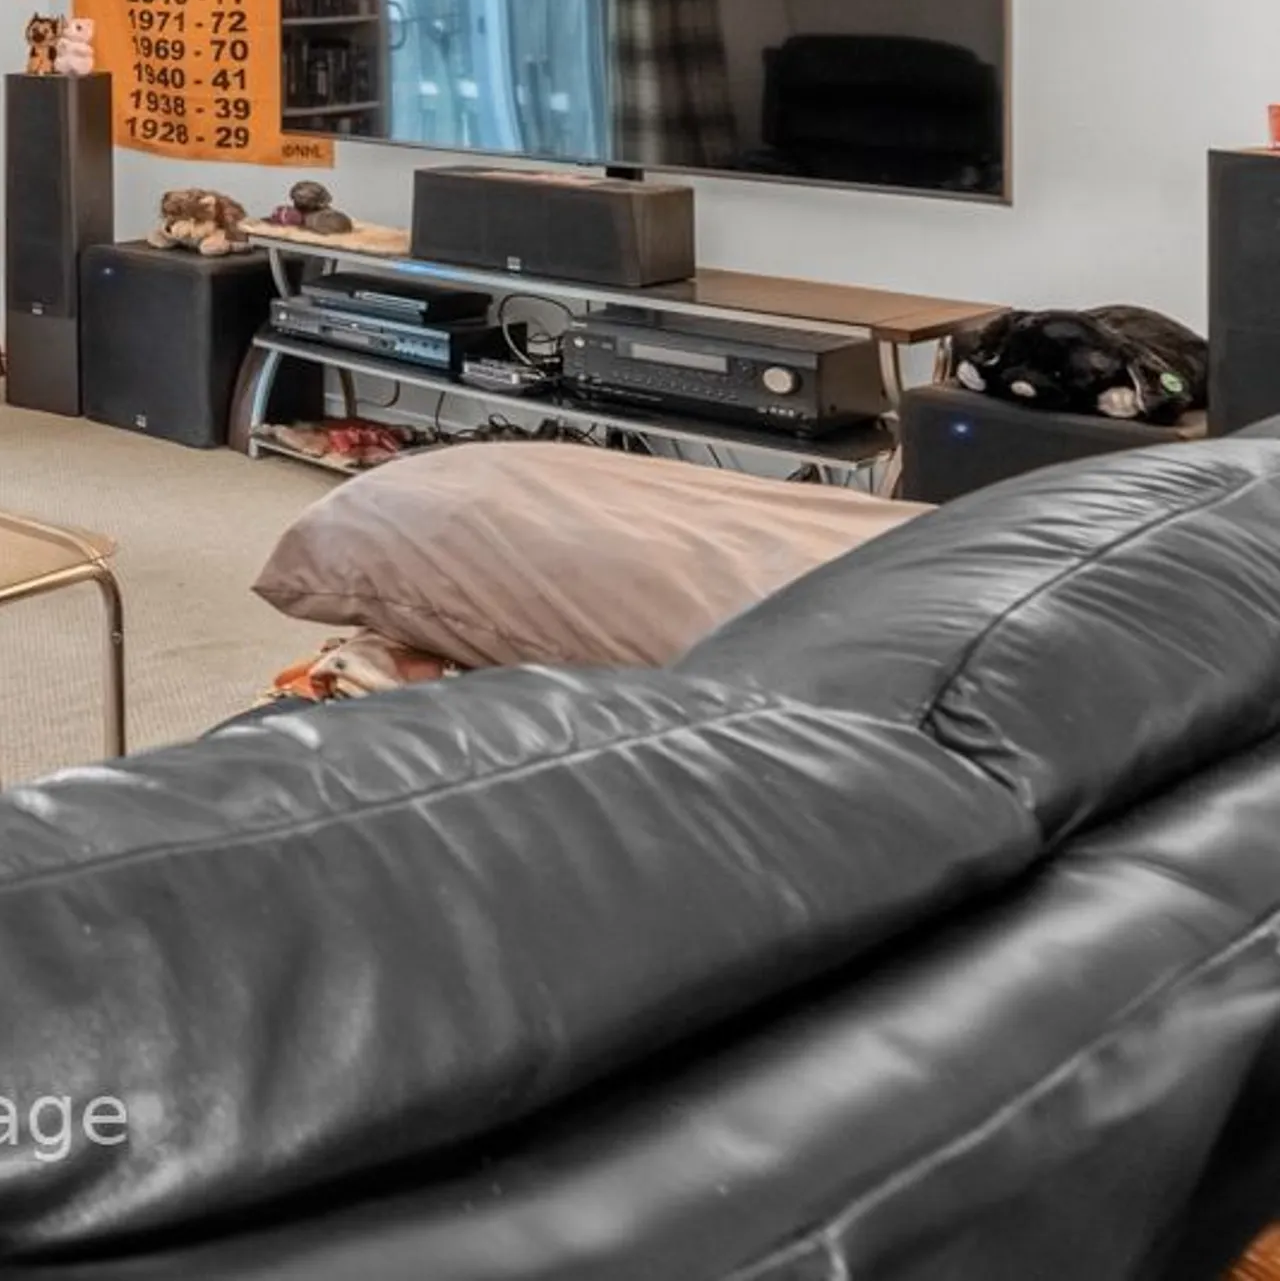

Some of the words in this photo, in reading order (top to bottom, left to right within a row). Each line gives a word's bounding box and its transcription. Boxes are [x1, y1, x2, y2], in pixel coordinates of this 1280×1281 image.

[128, 9, 186, 33] 1971
[211, 11, 248, 33] 72
[132, 35, 186, 61] 1969
[210, 40, 249, 62] 70
[133, 63, 186, 90] 1940
[211, 69, 247, 91] 41
[130, 89, 187, 116] 1938
[214, 98, 251, 121] 39
[124, 117, 189, 145] 1928
[214, 126, 250, 149] 29
